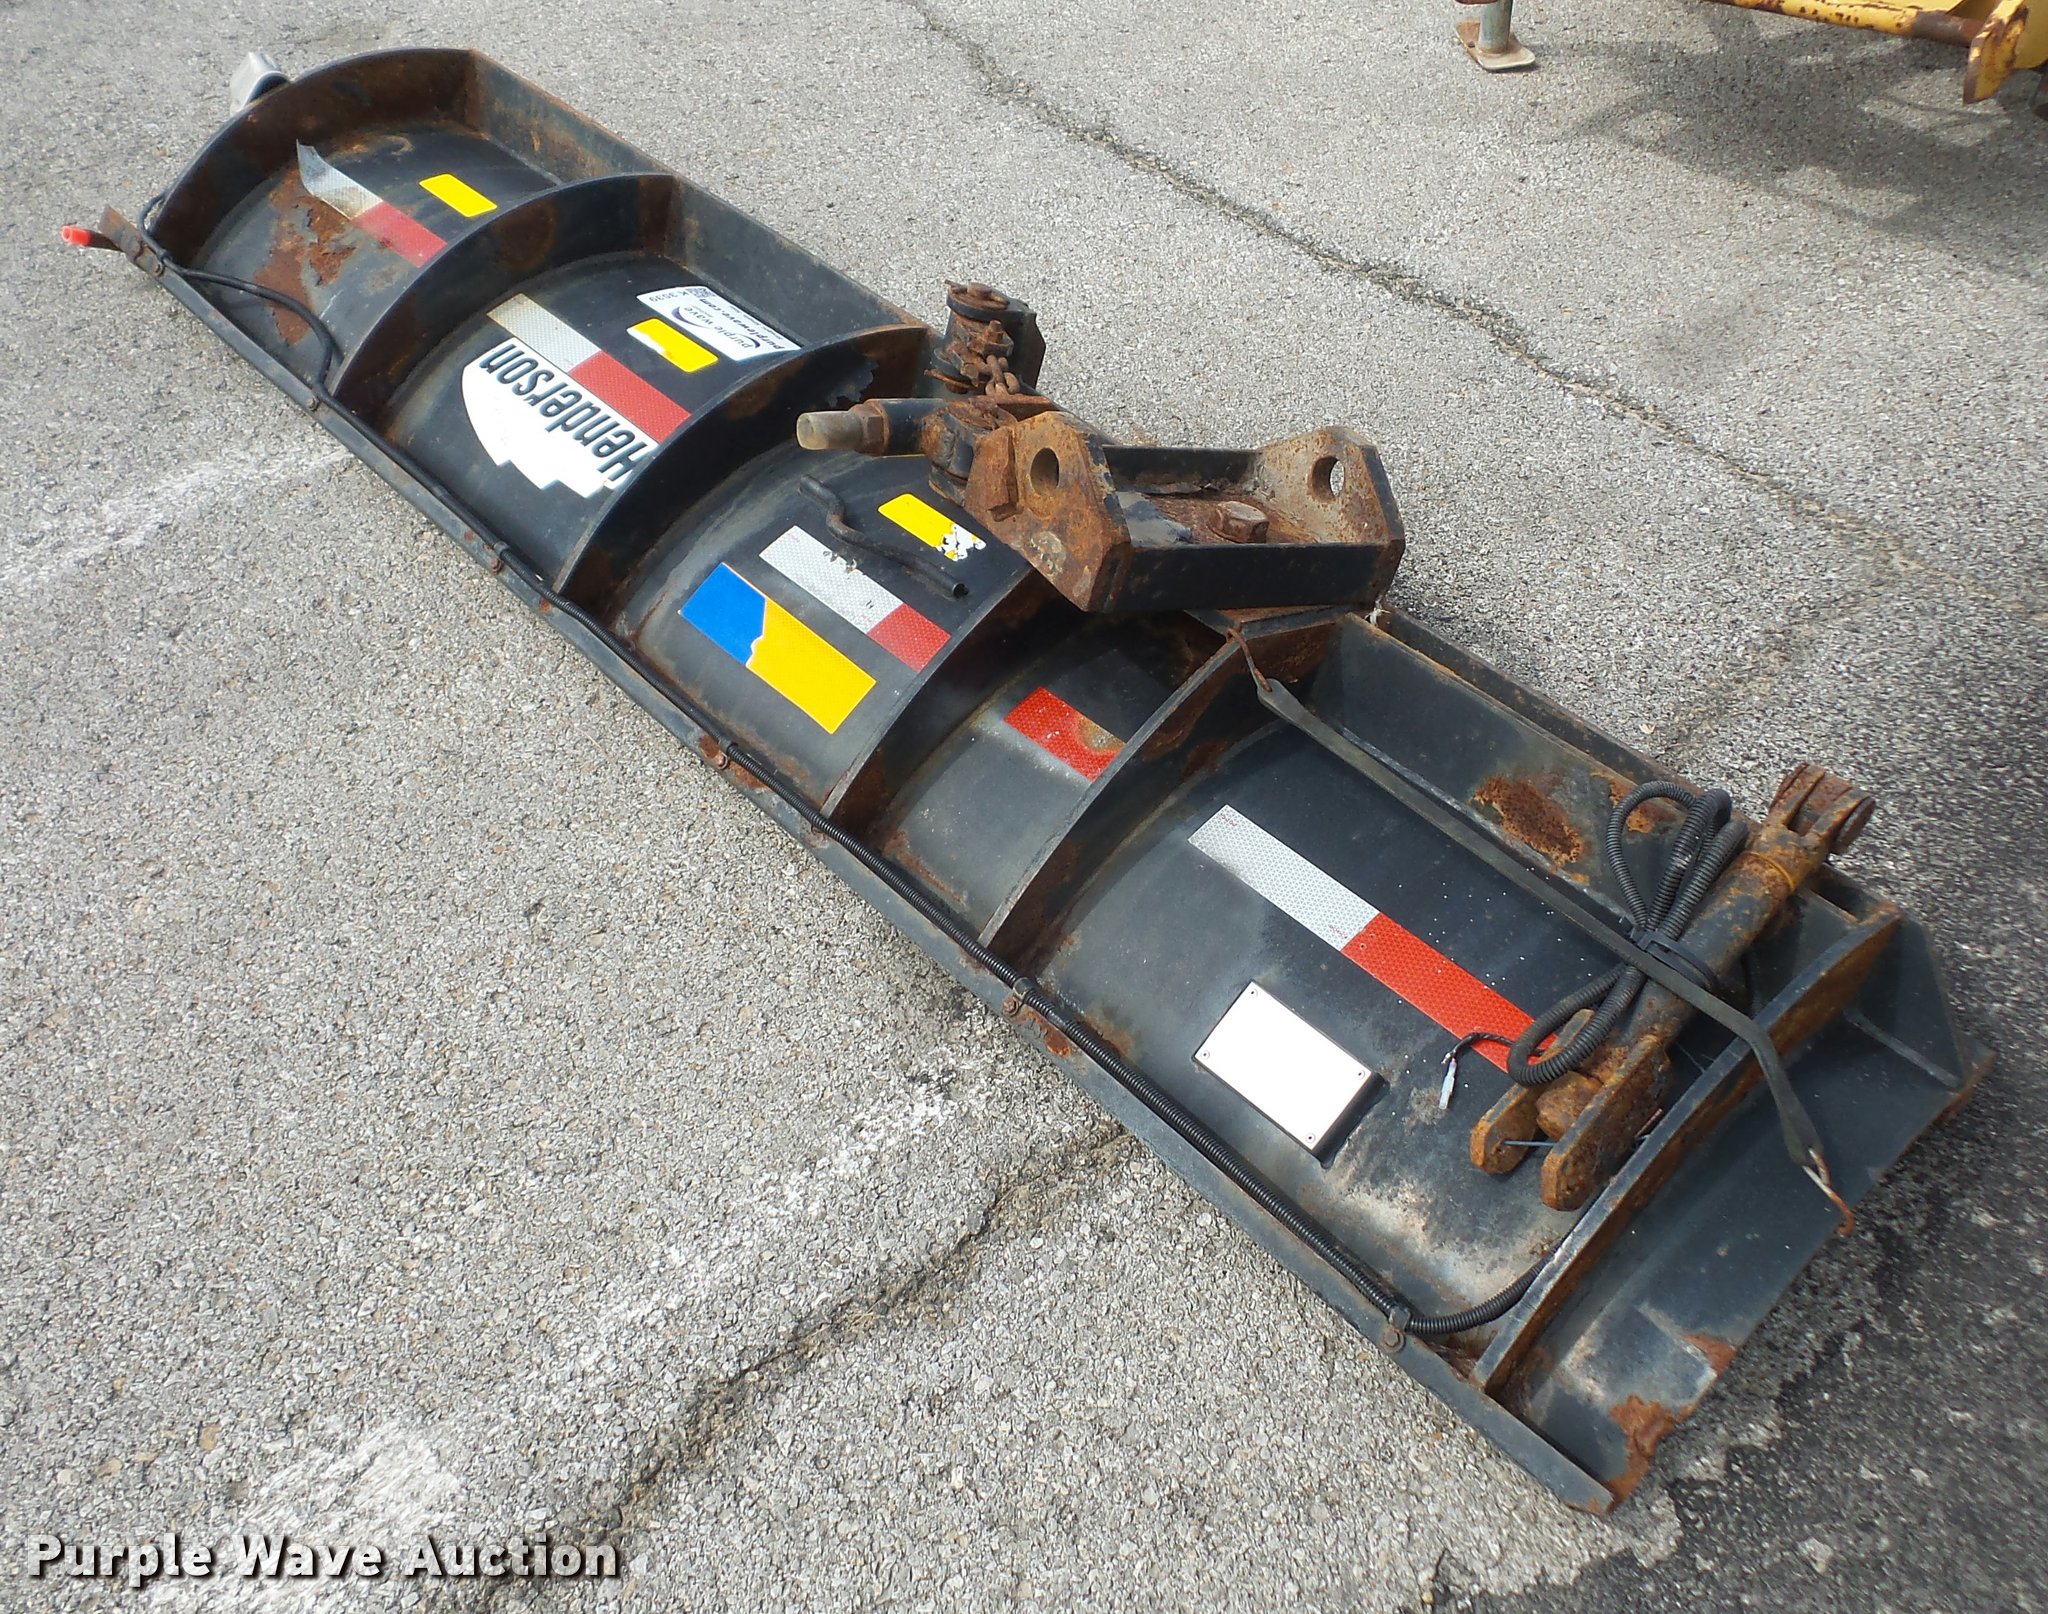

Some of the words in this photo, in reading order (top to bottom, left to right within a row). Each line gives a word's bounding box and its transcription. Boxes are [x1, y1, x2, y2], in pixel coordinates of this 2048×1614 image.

[684, 306, 713, 325] wave
[699, 298, 785, 350] purplewave.com
[713, 324, 752, 349] purple
[478, 343, 648, 483] Henderson
